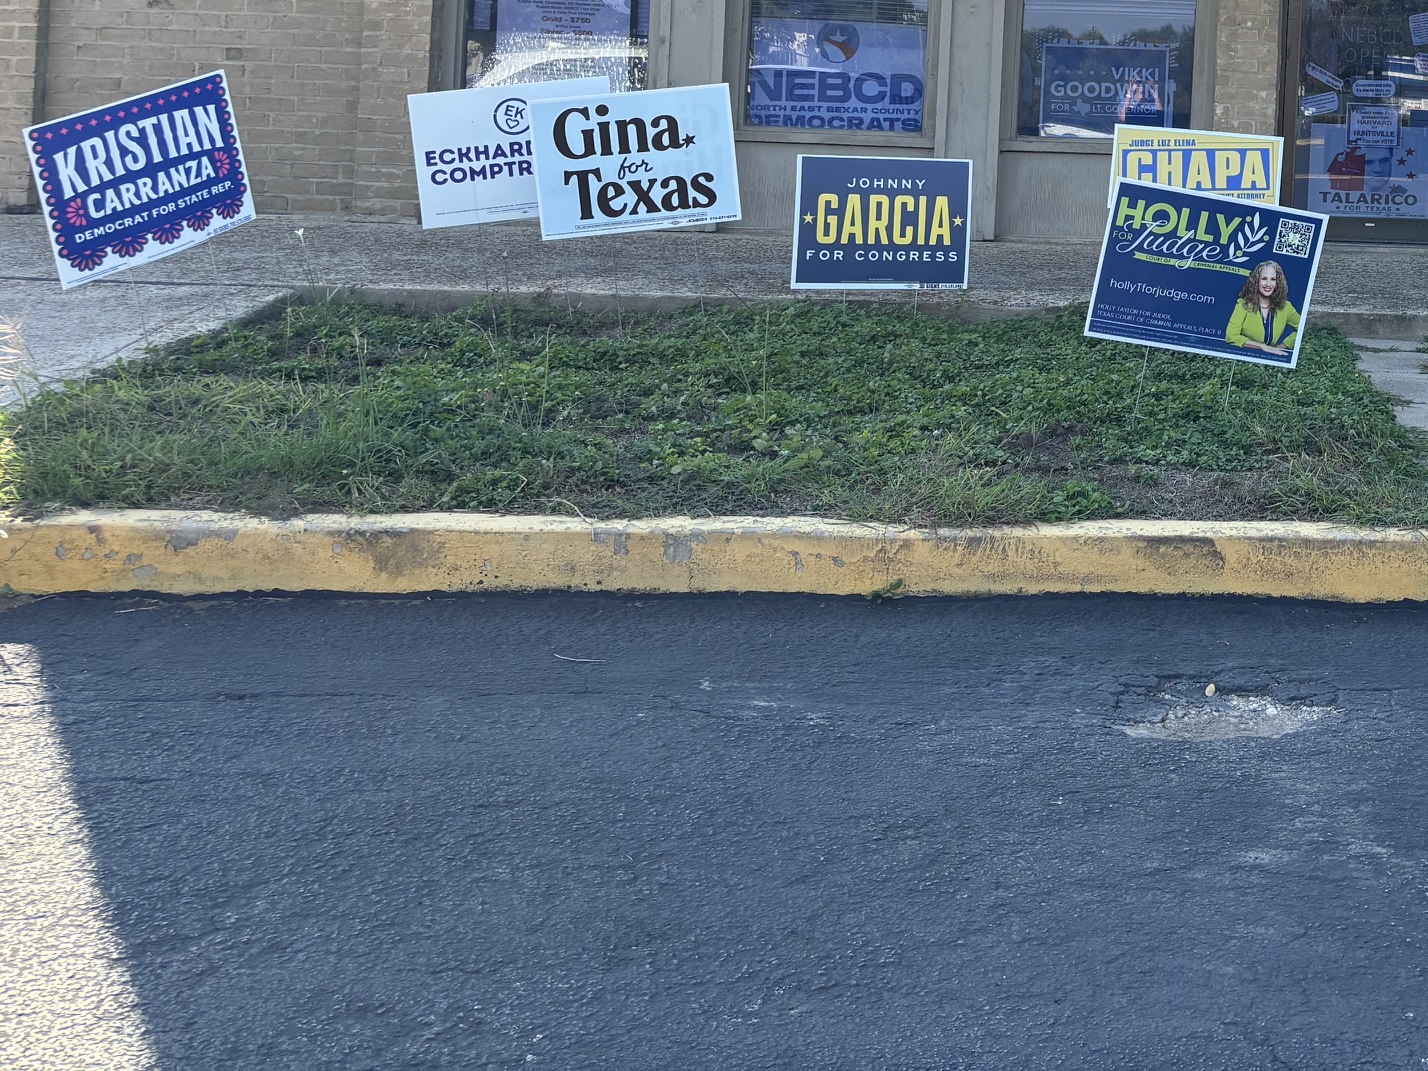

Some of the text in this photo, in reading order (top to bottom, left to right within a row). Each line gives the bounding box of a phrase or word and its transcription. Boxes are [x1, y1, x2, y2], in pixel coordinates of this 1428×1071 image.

[1111, 67, 1159, 80] VIKKI
[752, 69, 923, 105] NEBCD
[1050, 81, 1159, 100] GOODWIN
[504, 104, 526, 120] EK
[826, 106, 868, 114] BEXAR
[871, 107, 921, 116] COUNTY
[1092, 104, 1103, 112] LT.
[1105, 105, 1157, 114] GOVERNOR
[552, 104, 686, 160] Gina
[751, 114, 922, 132] DEMOCRATS
[52, 104, 225, 200] KRISTIAN
[1129, 139, 1196, 147] JUDGE LUZ ELENA
[430, 160, 534, 186] COMPTR
[618, 156, 653, 181] for
[1126, 150, 1268, 189] CHAPA
[86, 156, 216, 219] CARRANZA
[564, 168, 718, 221] Texas
[847, 177, 926, 189] JOHNNY
[1319, 191, 1418, 206] TALARICO
[75, 180, 234, 244] DEMOCRAT FOR STATE REP.
[816, 193, 951, 246] GARCIA
[1116, 196, 1243, 245] HOLLY
[806, 250, 958, 262] FOR CONGRESS
[1112, 220, 1223, 270] FOR Judge
[1109, 277, 1215, 305] hollyTforjudge.com
[1096, 310, 1172, 327] TEXAS COURT CRIMINAL
[1097, 303, 1139, 317] HOLLY TAYLOR
